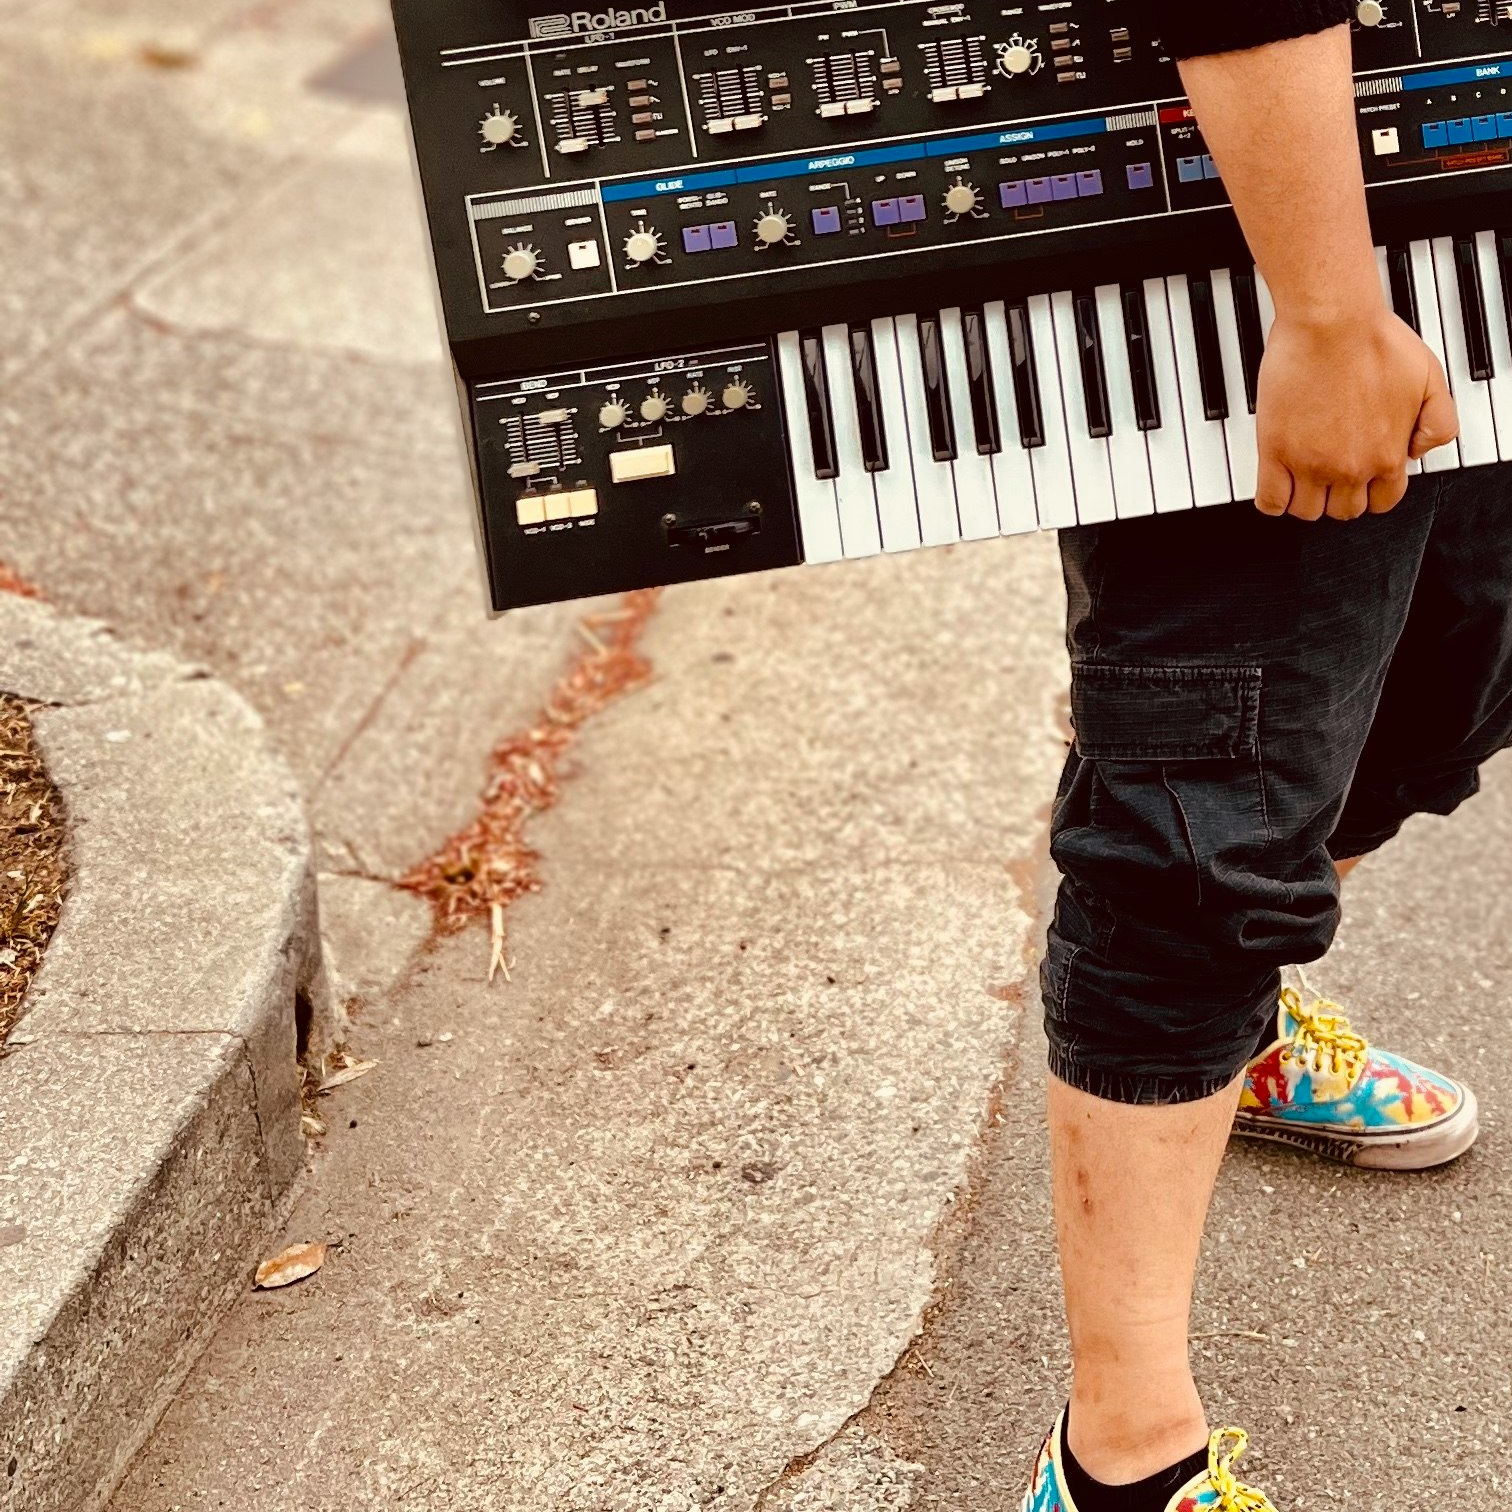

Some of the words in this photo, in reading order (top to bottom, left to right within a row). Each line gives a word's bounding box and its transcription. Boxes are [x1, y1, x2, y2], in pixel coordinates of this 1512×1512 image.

[571, 0, 667, 33] Roland
[1475, 66, 1500, 77] BANK
[1000, 131, 1034, 143] ASSIGN
[808, 156, 855, 169] ARPEGGIO
